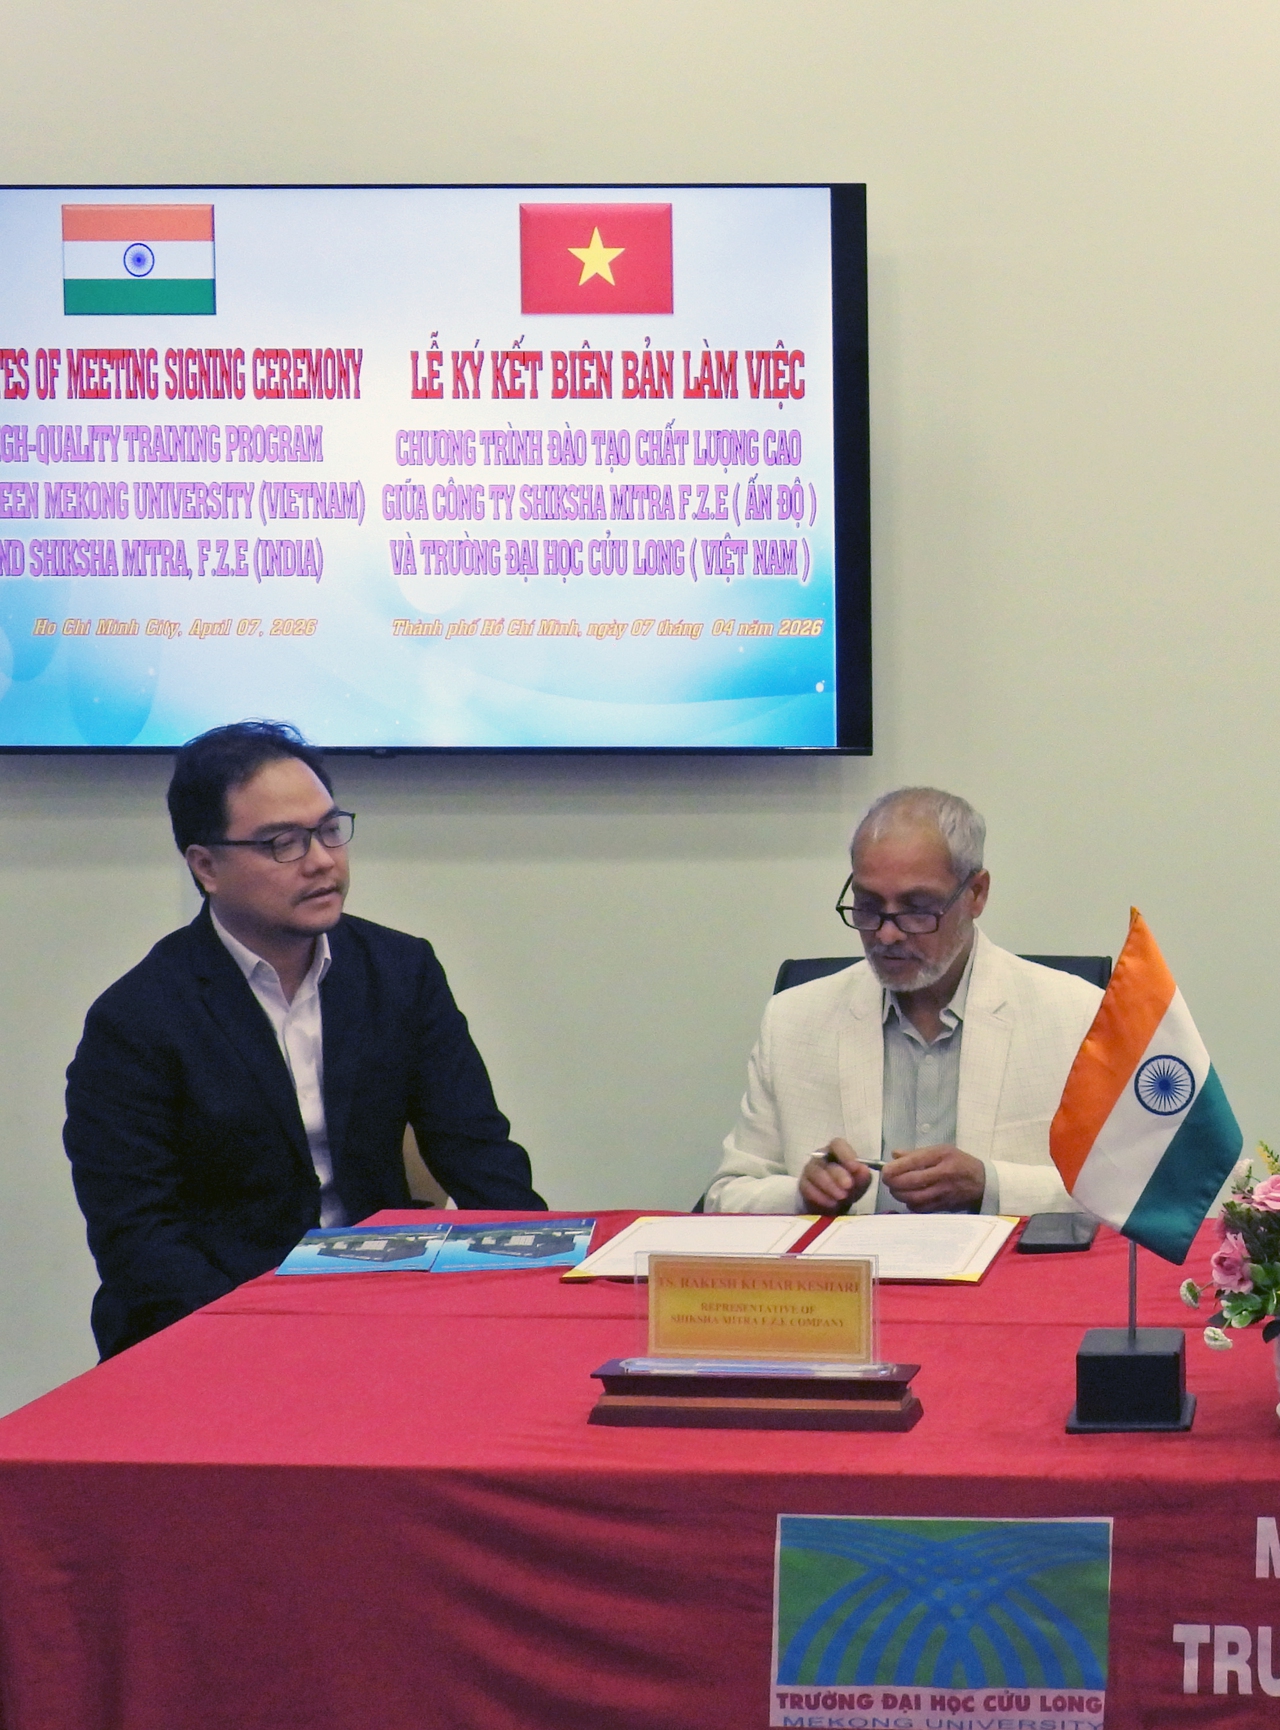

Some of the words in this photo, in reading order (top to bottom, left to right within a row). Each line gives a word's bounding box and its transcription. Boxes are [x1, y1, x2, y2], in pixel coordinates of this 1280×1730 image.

[0, 348, 29, 400] ES
[36, 348, 61, 400] OF
[66, 348, 158, 400] MEETING
[165, 348, 245, 400] SIGNING
[253, 348, 363, 400] CEREMONY
[411, 331, 443, 399] LỄ
[451, 339, 484, 399] KÝ
[491, 335, 543, 399] KẾT
[550, 340, 612, 399] BIÊN
[621, 336, 674, 399] BẢN
[683, 339, 738, 399] LÀM
[746, 339, 806, 410] VIỆC
[0, 425, 121, 465] GH-QUALITY
[123, 425, 220, 462] TRAINING
[225, 425, 323, 462] PROGRAM
[479, 421, 543, 466] TRÌNH
[547, 421, 587, 466] ĐÀO
[591, 429, 630, 473] TẠO
[635, 418, 689, 466] CHẤT
[763, 429, 802, 466] CAO
[0, 482, 39, 519] EEN
[44, 482, 129, 519] MEKONG
[133, 482, 254, 519] UNIVERSITY
[259, 480, 365, 526] (VIETNAM)
[433, 477, 485, 521] CÔNG
[489, 484, 515, 520] TY
[519, 484, 607, 521] SHIKSHA
[610, 484, 676, 521] MITRA
[29, 539, 118, 577] SHIKSHA
[121, 539, 192, 580] MITRA,
[197, 539, 249, 577] F.Z.E
[253, 537, 323, 584] (INDIA)
[390, 532, 417, 575] VÀ
[420, 531, 500, 576] TRƯỜNG
[505, 539, 539, 584] ĐẠI
[543, 539, 583, 584] HỌC
[588, 530, 628, 576] CỬU
[633, 539, 685, 576] LONG
[33, 619, 57, 636] Ho
[62, 619, 91, 636] Chi
[95, 619, 139, 636] Minh
[145, 619, 182, 639] City,
[189, 619, 231, 639] April
[236, 619, 262, 638] 07,
[270, 619, 318, 636] 2026
[392, 618, 444, 637] Thành
[445, 618, 480, 640] phố
[508, 618, 535, 637] Chí
[537, 618, 582, 638] Minh,
[586, 619, 627, 640] ngày
[630, 619, 654, 637] 07
[657, 619, 702, 640] tháng
[711, 619, 734, 637] 04
[738, 619, 773, 637] năm
[778, 619, 823, 637] 2026
[680, 1278, 736, 1291] RAKESH
[741, 1280, 793, 1292] KUMAR
[701, 1302, 799, 1315] REPRESENTATIVE
[801, 1305, 816, 1314] OF
[789, 1318, 845, 1328] COMPANY
[776, 1692, 874, 1711] TRƯỜNG
[881, 1693, 921, 1715] ĐẠI
[931, 1695, 975, 1716] HỌC
[983, 1690, 1030, 1713] CỬU
[1040, 1695, 1103, 1714] LONG
[783, 1716, 913, 1730] MEKONG
[926, 1718, 1104, 1730] UNIVERSITY
